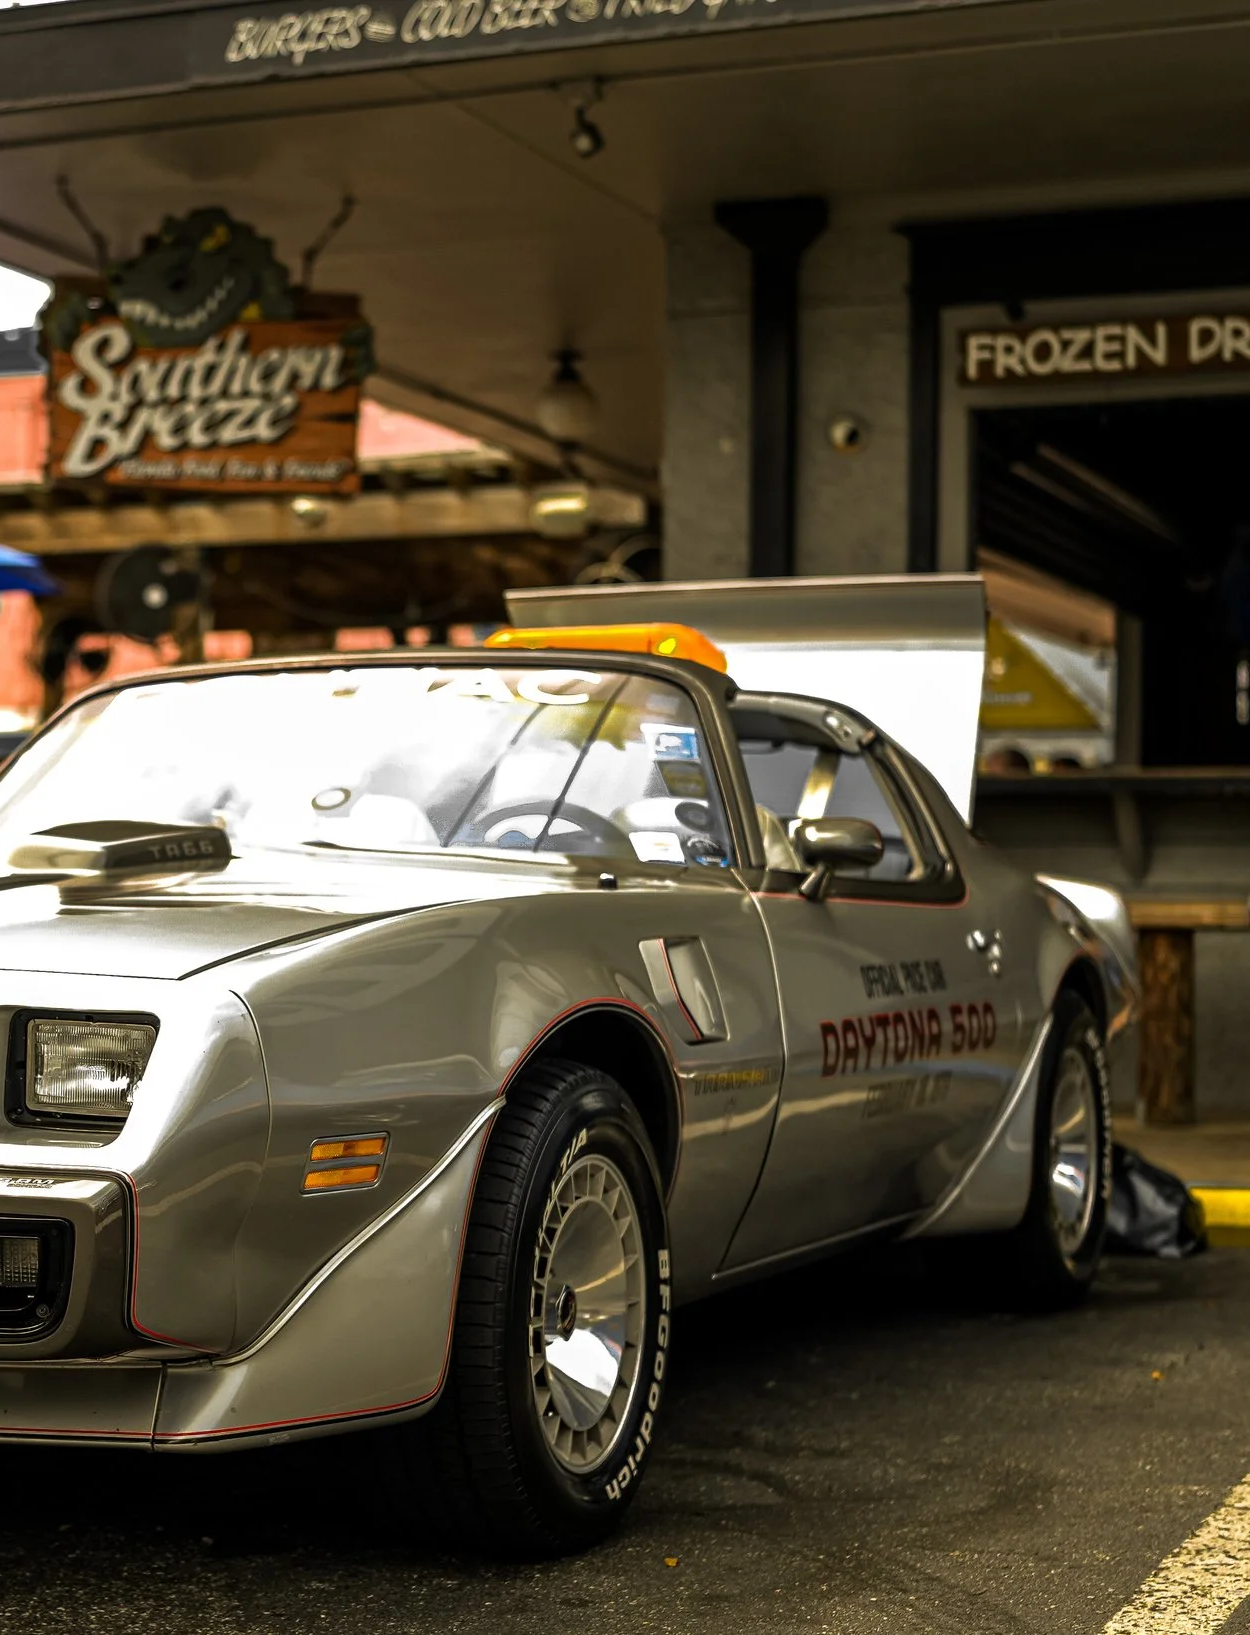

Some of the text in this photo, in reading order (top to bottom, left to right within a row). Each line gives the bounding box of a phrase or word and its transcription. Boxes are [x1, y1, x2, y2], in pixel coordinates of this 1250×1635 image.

[225, 5, 372, 66] BURGERS
[402, 0, 483, 43] COLD
[59, 322, 347, 412] Southern
[965, 319, 1168, 381] FROZEN
[62, 394, 300, 478] Breeze
[820, 1001, 997, 1078] DAYTONA 500
